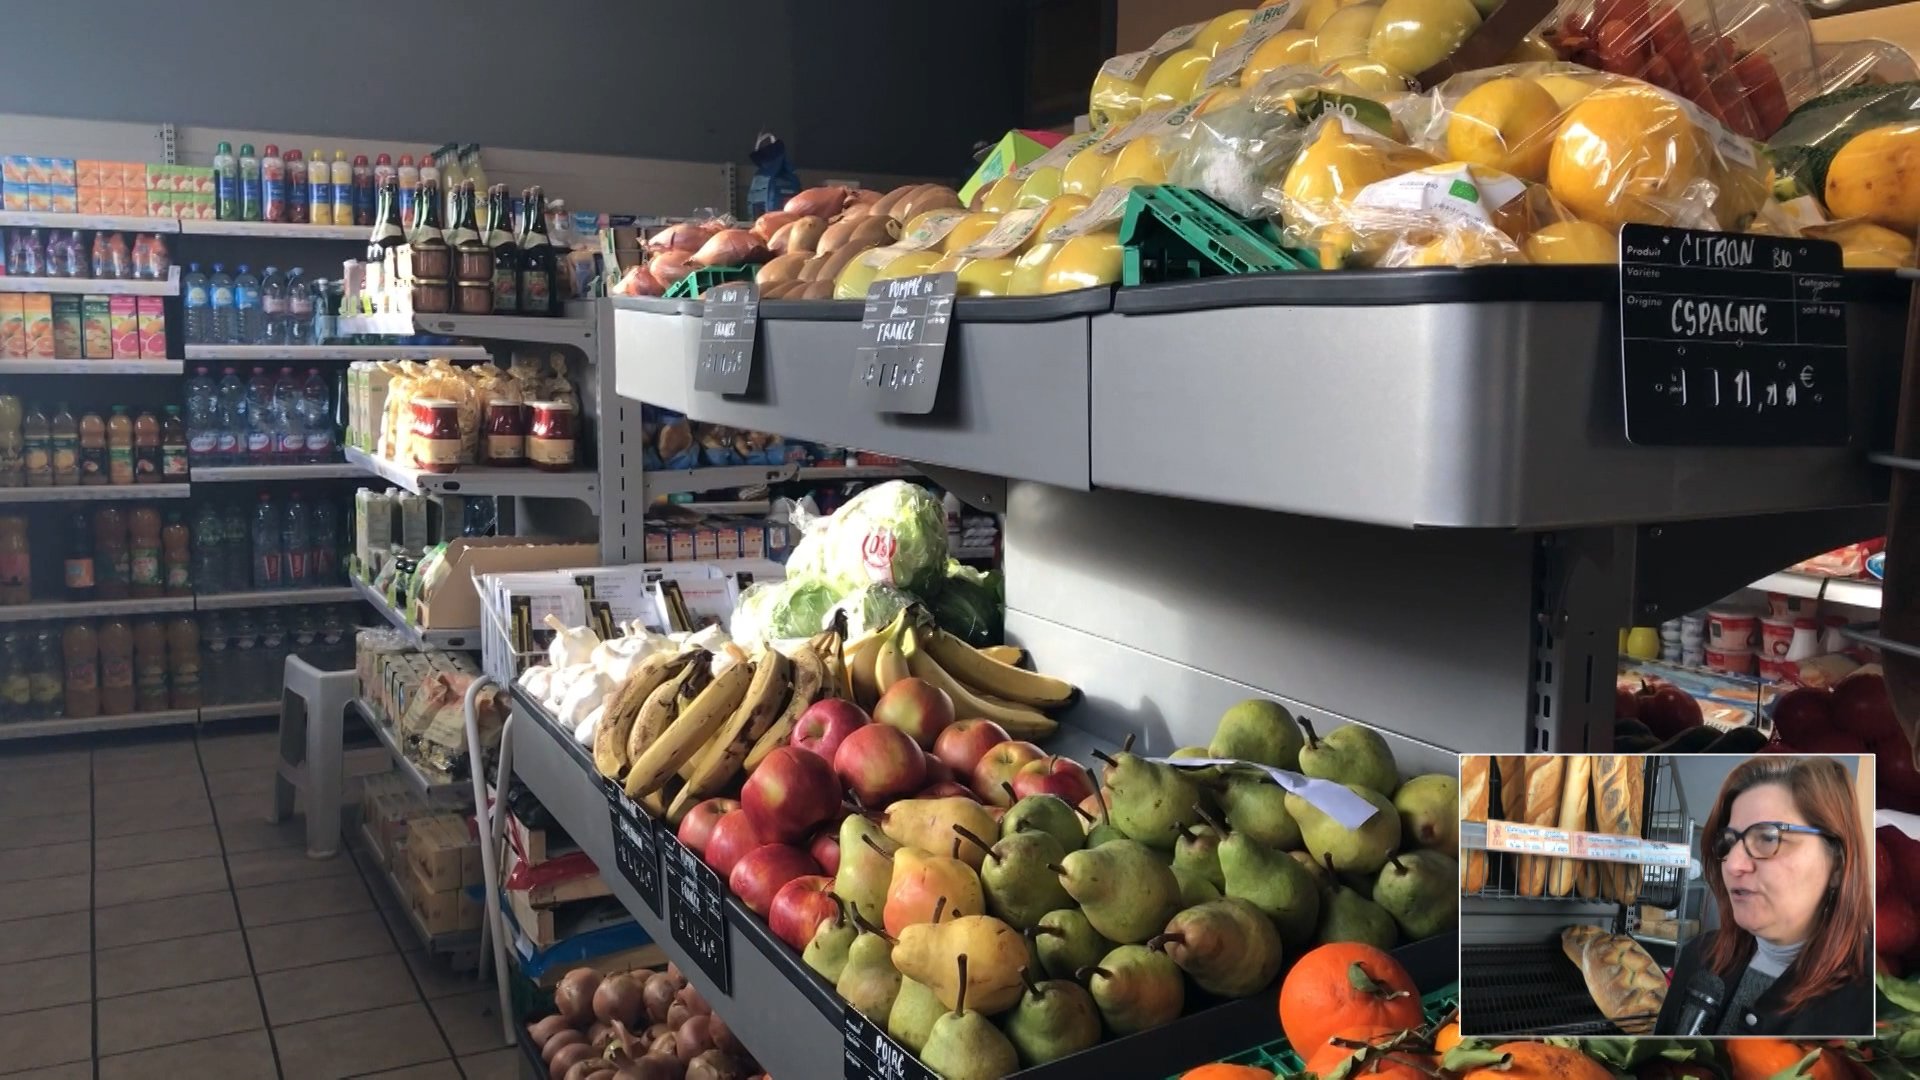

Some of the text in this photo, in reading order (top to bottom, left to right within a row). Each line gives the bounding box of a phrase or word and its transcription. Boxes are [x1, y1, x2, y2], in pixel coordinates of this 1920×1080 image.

[1627, 233, 1792, 268] Produit CITRON BIO
[1627, 295, 1662, 308] Origine
[877, 319, 916, 342] FRANCE
